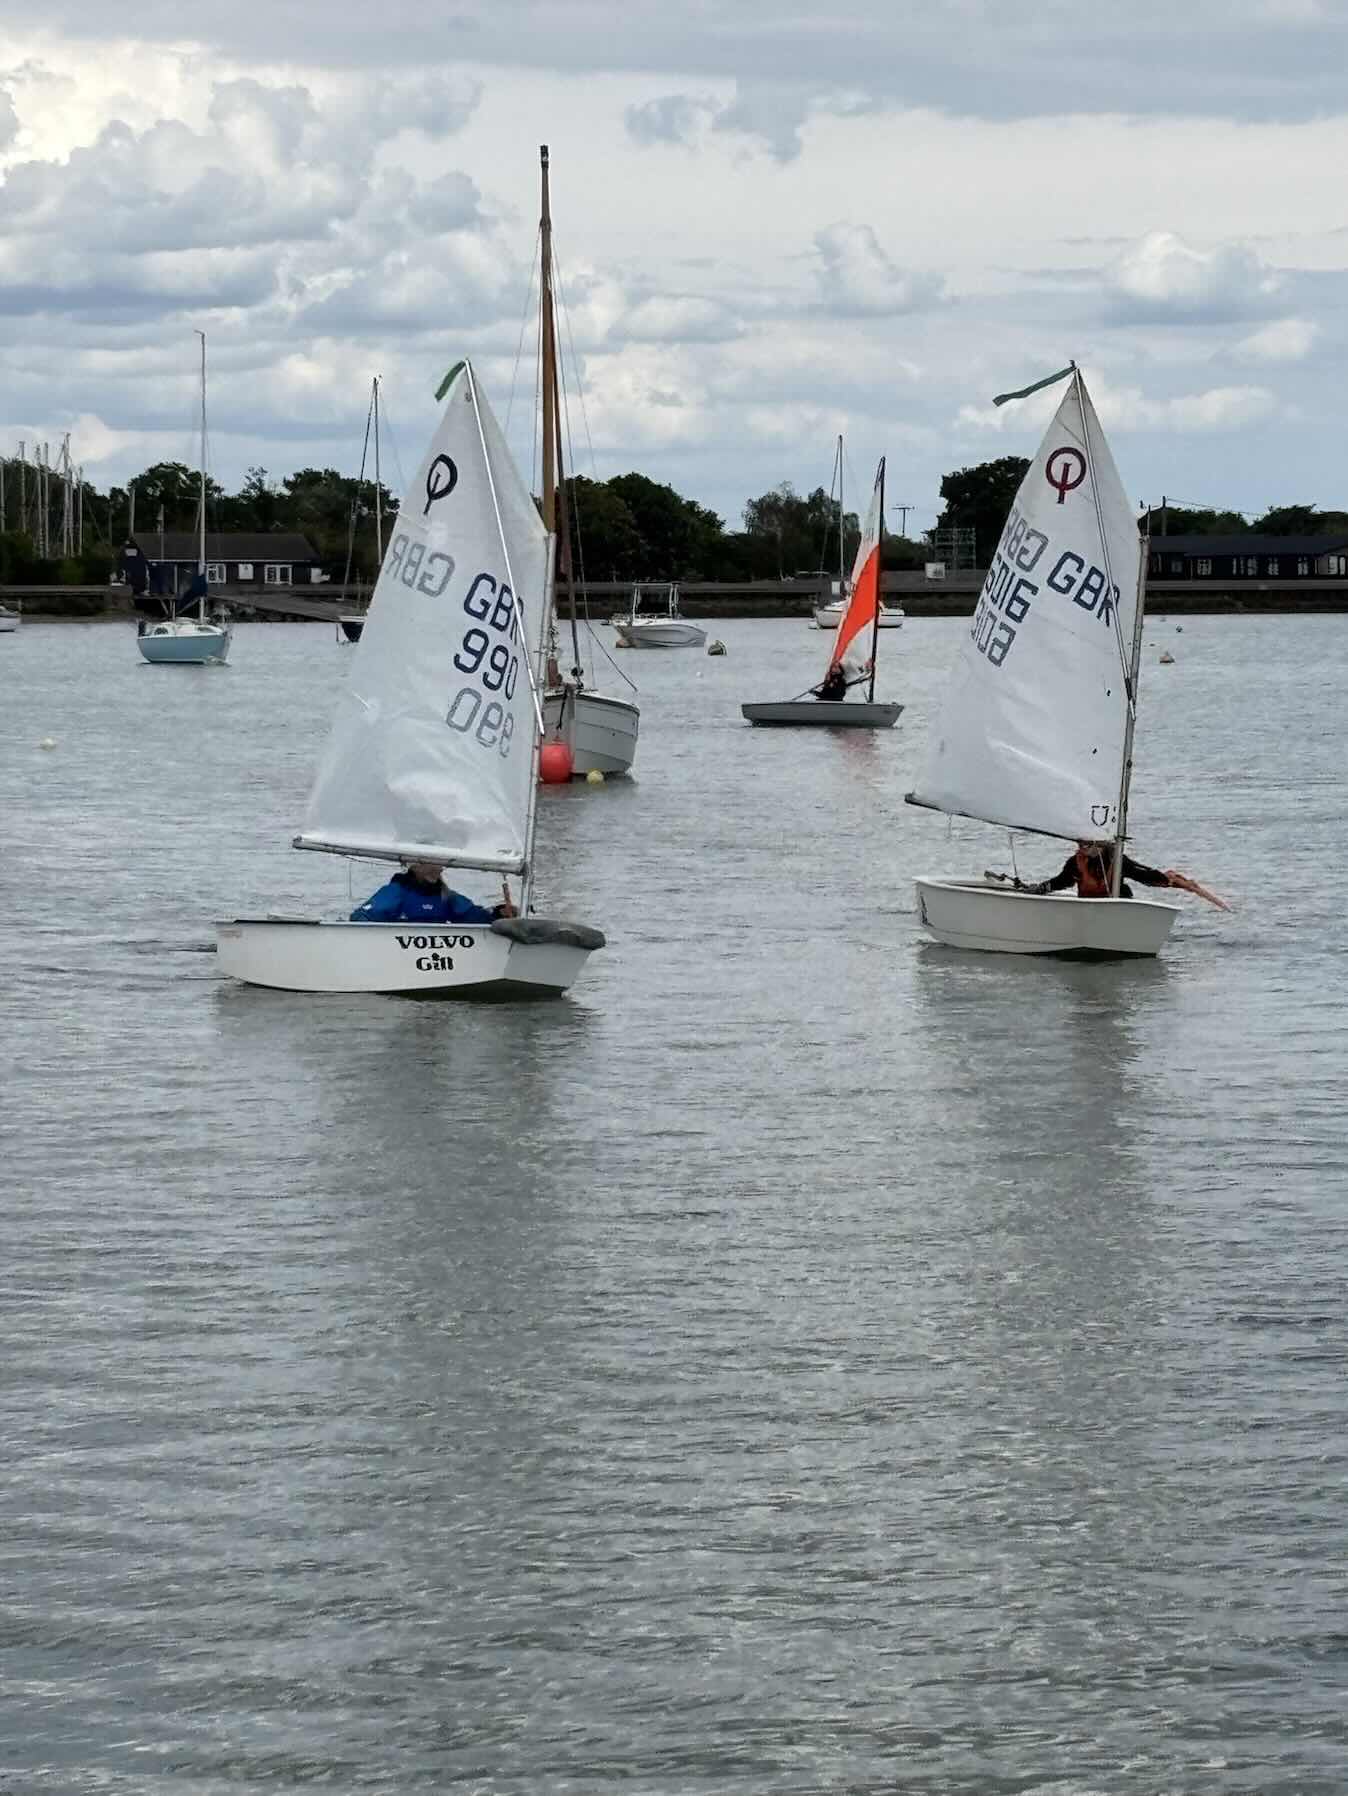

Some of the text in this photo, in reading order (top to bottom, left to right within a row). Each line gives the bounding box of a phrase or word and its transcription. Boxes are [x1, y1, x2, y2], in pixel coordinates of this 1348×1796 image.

[463, 572, 524, 646] GBR
[1046, 551, 1121, 628] GBR
[453, 628, 519, 701] 990
[395, 935, 475, 949] VOLVO
[416, 952, 454, 971] Gill
